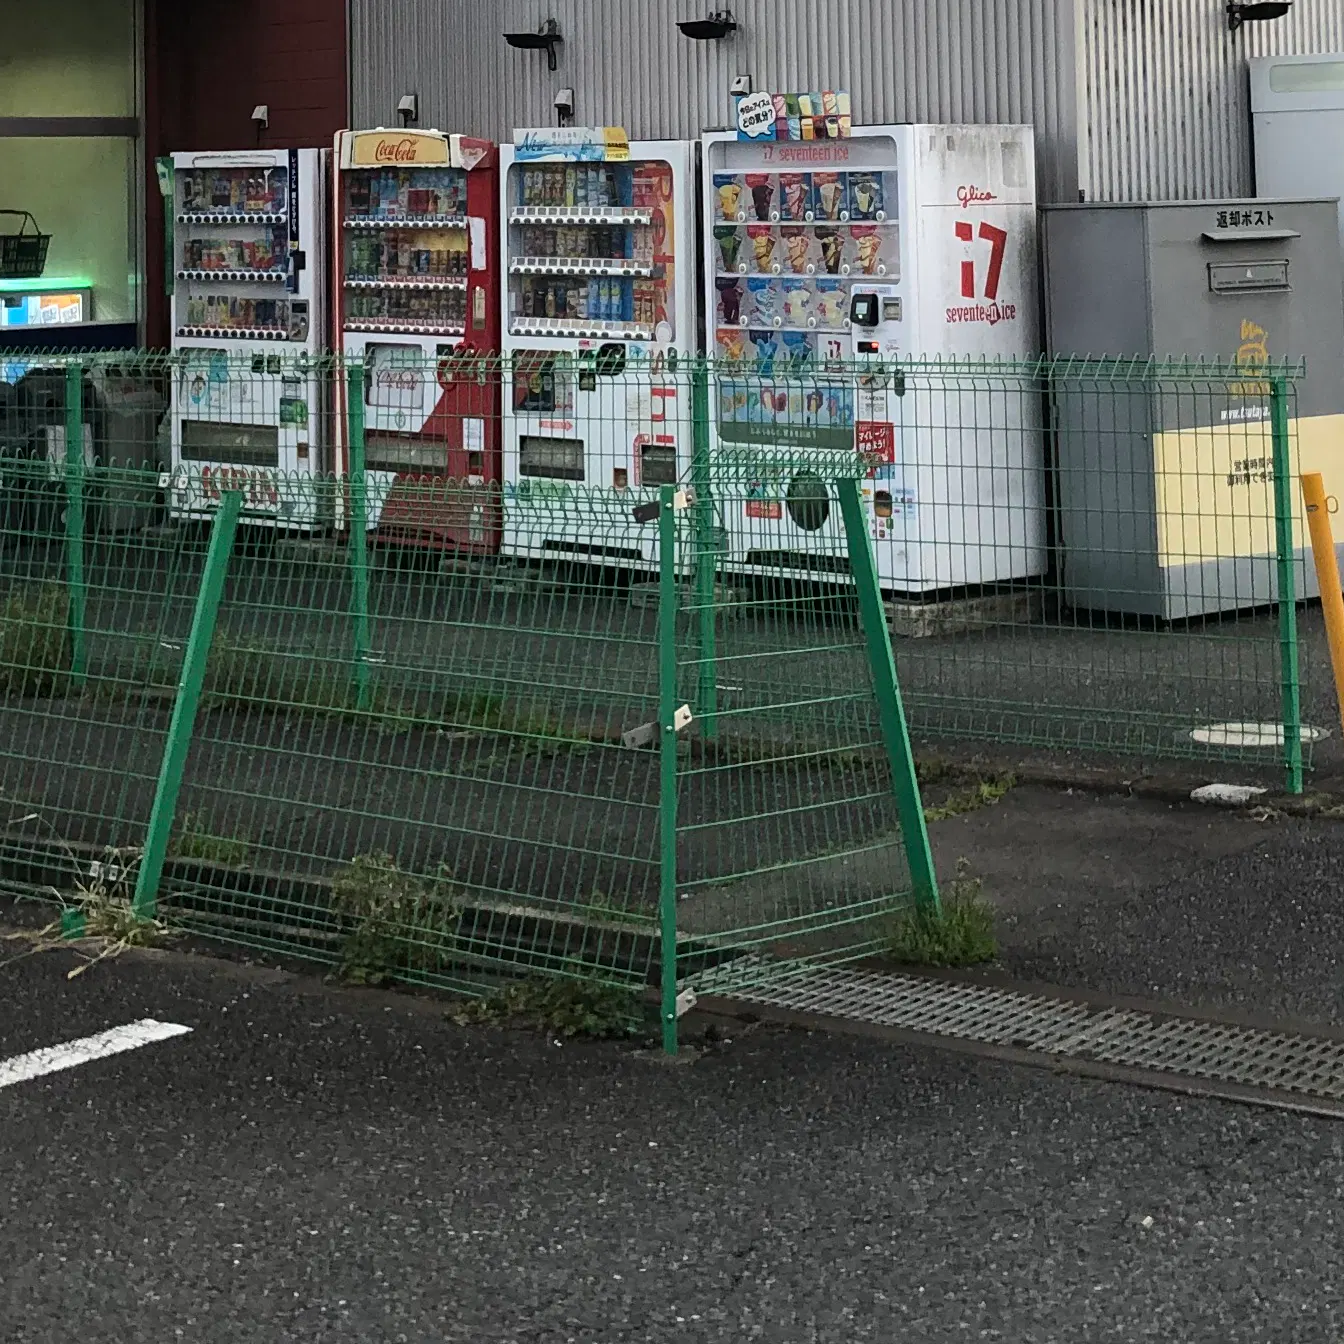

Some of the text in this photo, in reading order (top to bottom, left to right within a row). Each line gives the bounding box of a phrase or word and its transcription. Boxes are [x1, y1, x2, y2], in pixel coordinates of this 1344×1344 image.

[779, 147, 830, 162] seventeen
[957, 185, 997, 208] Glico
[1217, 210, 1274, 228] 返却ポスト
[946, 302, 1001, 326] seventeen
